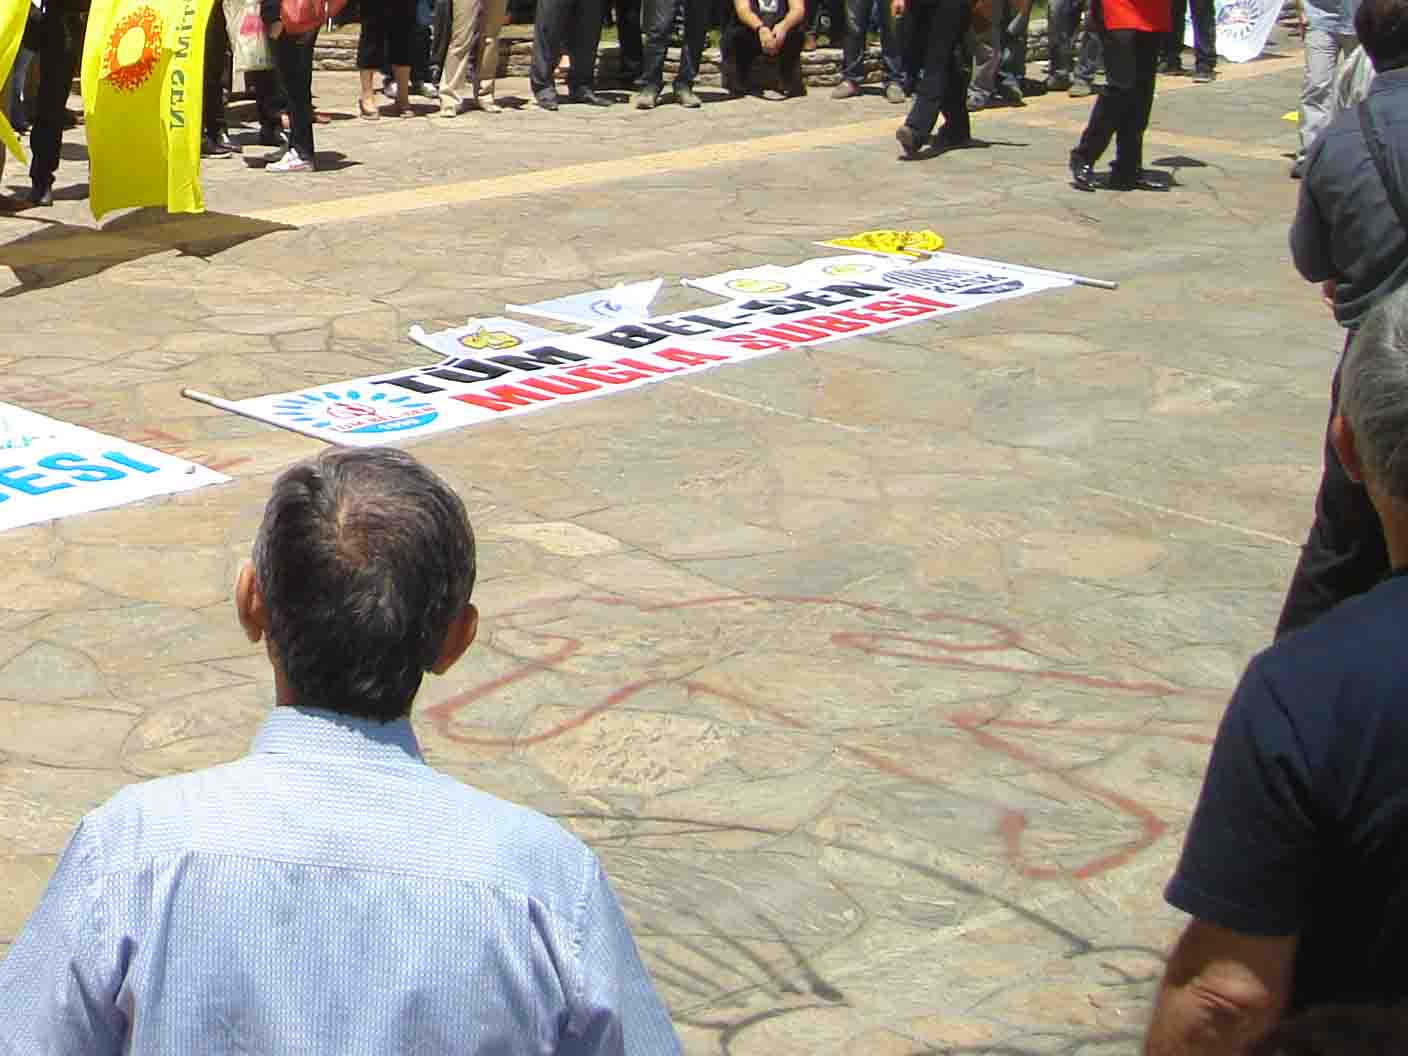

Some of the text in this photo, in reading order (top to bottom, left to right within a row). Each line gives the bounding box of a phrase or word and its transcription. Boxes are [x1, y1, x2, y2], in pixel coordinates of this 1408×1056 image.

[367, 279, 894, 394] TÜM BEL-SEN
[449, 291, 960, 413] MUĞLA ŞUBESİ
